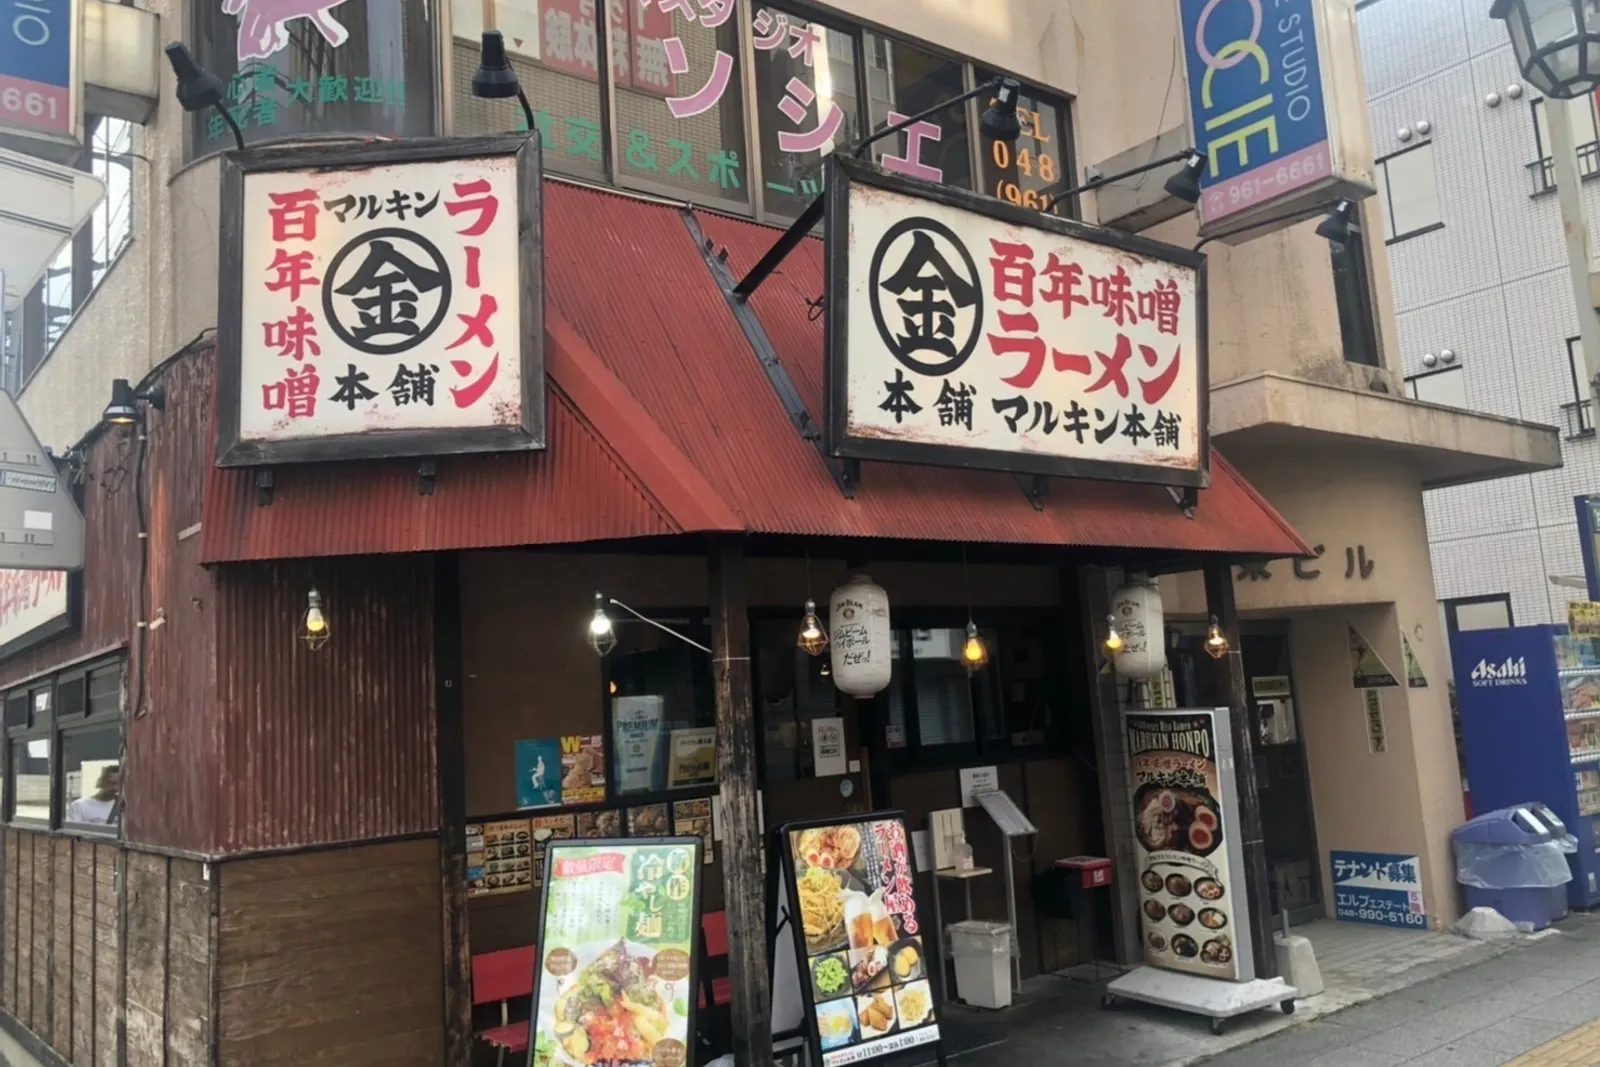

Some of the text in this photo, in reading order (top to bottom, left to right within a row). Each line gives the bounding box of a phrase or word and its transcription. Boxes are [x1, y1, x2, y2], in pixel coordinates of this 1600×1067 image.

[1278, 13, 1311, 122] STUDIO
[993, 140, 1055, 183] 048
[1228, 151, 1324, 204] 961-6661
[323, 189, 441, 223] マルキン
[262, 188, 321, 419] 百年味噌
[331, 238, 445, 347] 金
[443, 178, 499, 410] ラーメン
[878, 228, 977, 361] 金
[988, 237, 1182, 337] 百年味噌
[986, 309, 1181, 406] ラーメン
[329, 363, 441, 411] 本舗
[878, 368, 977, 431] 本舗
[991, 395, 1182, 450] マルキン本舗
[1471, 656, 1526, 680] Asahi
[1472, 677, 1528, 688] SOFT DRINKS
[1170, 728, 1209, 758] HONPO
[1334, 860, 1417, 884] テナント募集
